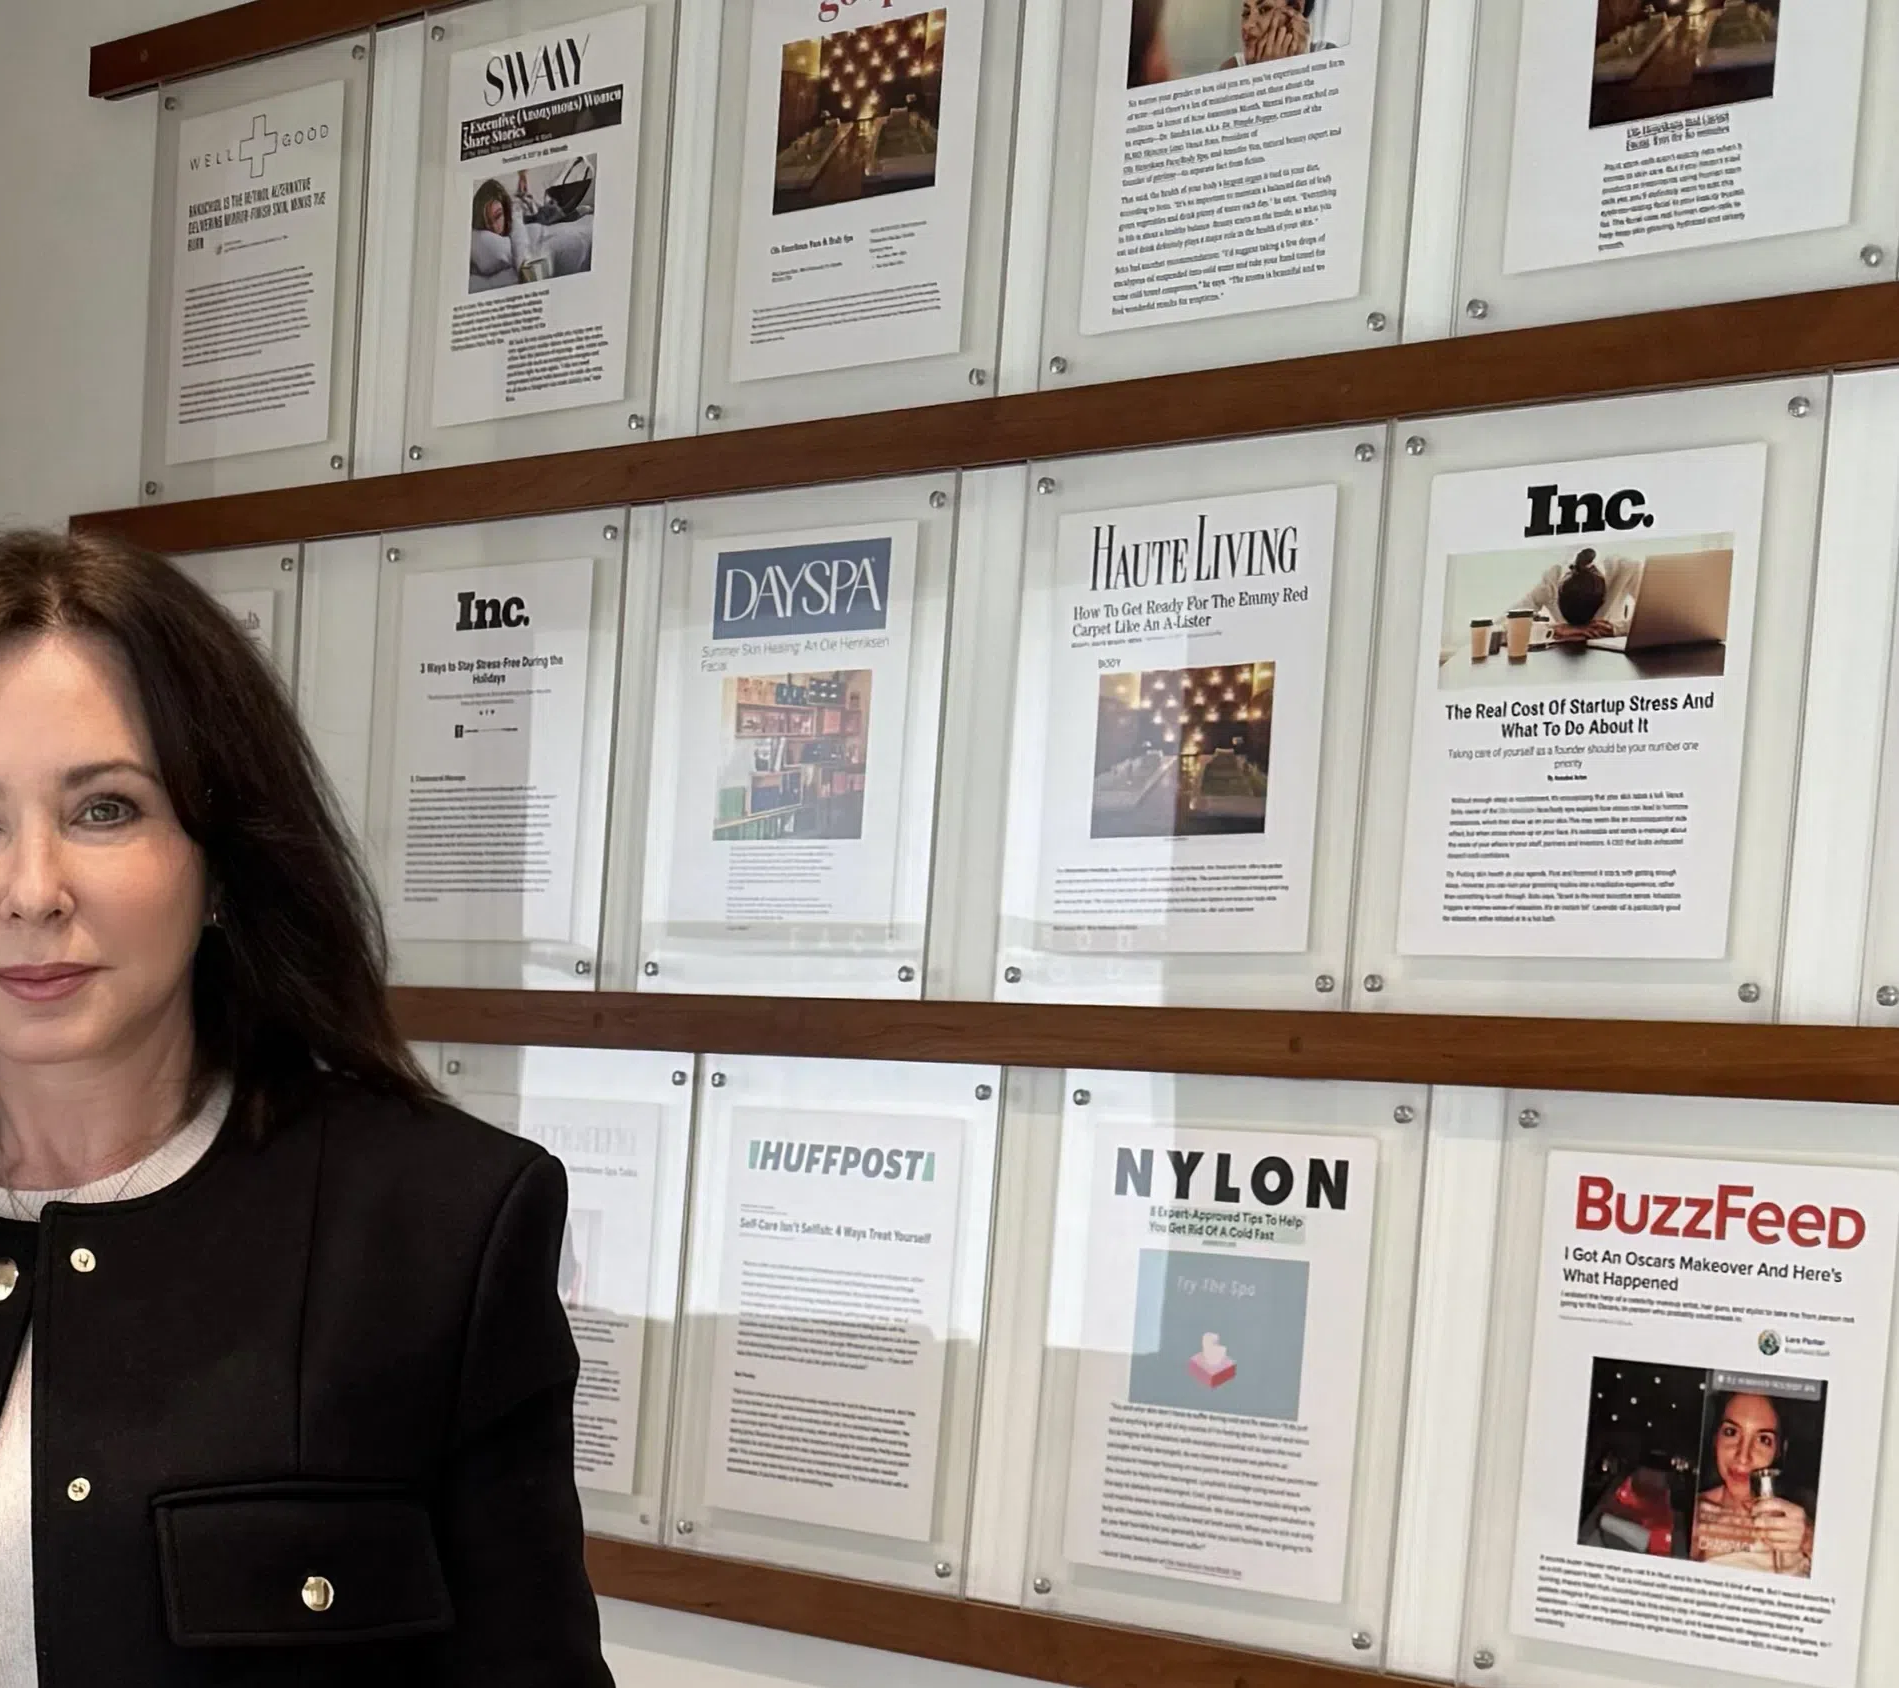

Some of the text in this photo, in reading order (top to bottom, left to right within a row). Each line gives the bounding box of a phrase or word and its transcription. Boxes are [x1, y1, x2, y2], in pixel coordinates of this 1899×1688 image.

[469, 110, 516, 135] Executive
[516, 94, 582, 126] (Anonymous)
[583, 85, 622, 108] Women
[281, 122, 329, 148] GOOD
[462, 130, 490, 151] Share
[491, 121, 526, 144] Stories
[189, 147, 233, 171] WELL
[1523, 484, 1654, 538] Inc.
[1089, 514, 1298, 592] HAUTE LIVING
[722, 555, 882, 622] DAYSPA
[1072, 585, 1309, 621] How To Get Ready For The Emmy Red
[456, 590, 531, 631] Inc.
[1071, 612, 1211, 640] Carpet Like An A-Lister
[426, 660, 446, 675] Ways
[447, 660, 456, 672] to
[457, 658, 474, 673] Stay
[475, 656, 520, 671] Stress-Free
[521, 654, 548, 670] During
[549, 653, 563, 666] the
[471, 671, 506, 687] Holidays
[1444, 691, 1715, 720] The Real Cost Of Startup Stress And
[1500, 716, 1649, 738] What To Do About It
[759, 1140, 924, 1181] HUFFPOST
[1115, 1147, 1350, 1210] NYLON
[1157, 1206, 1240, 1225] Expert-Approved
[1242, 1212, 1263, 1226] Tips
[1264, 1213, 1277, 1226] To
[1278, 1214, 1303, 1229] Help
[1575, 1175, 1867, 1250] BuzzFeed
[739, 1216, 778, 1231] Self-Care
[778, 1220, 799, 1233] Isn't
[834, 1224, 841, 1237] 4
[842, 1225, 866, 1242] Ways
[868, 1227, 892, 1241] Treat
[893, 1229, 931, 1244] Yourself
[1148, 1221, 1275, 1241] You Get Rid Of A Cold Fast
[1563, 1246, 1843, 1283] I Got An Oscars Makeover And Here's
[1562, 1267, 1678, 1294] What Happened
